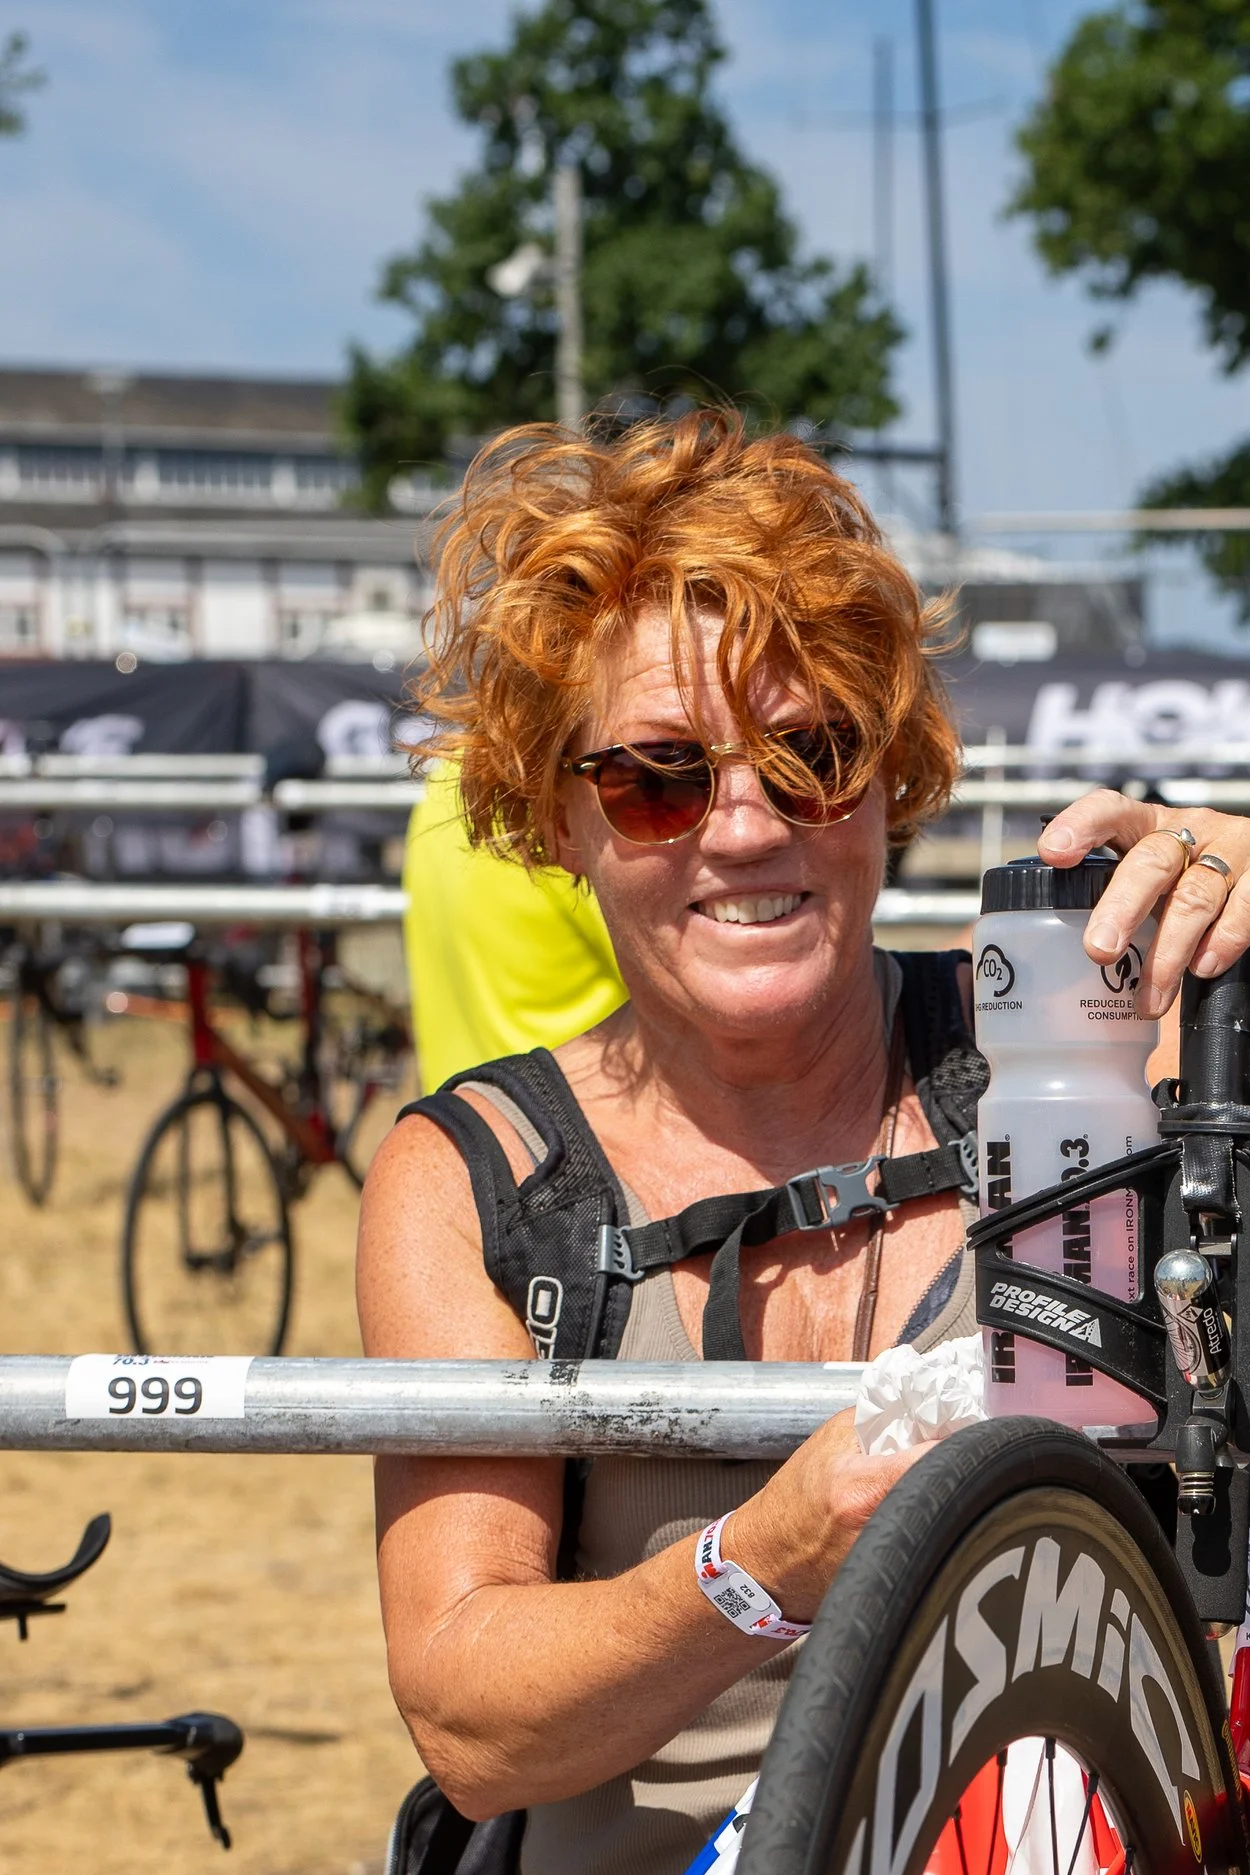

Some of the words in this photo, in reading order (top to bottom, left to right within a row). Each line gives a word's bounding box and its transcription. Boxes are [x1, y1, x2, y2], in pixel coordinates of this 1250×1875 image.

[982, 1001, 1023, 1011] REDUCTION
[1080, 999, 1125, 1008] REDUCED
[1087, 1011, 1144, 1021] CONSUMPTI
[989, 1294, 1081, 1334] DESIGN
[990, 1281, 1092, 1323] PROFILE
[1203, 1307, 1222, 1355] Atredo
[107, 1376, 204, 1415] 999
[739, 1583, 756, 1599] 832
